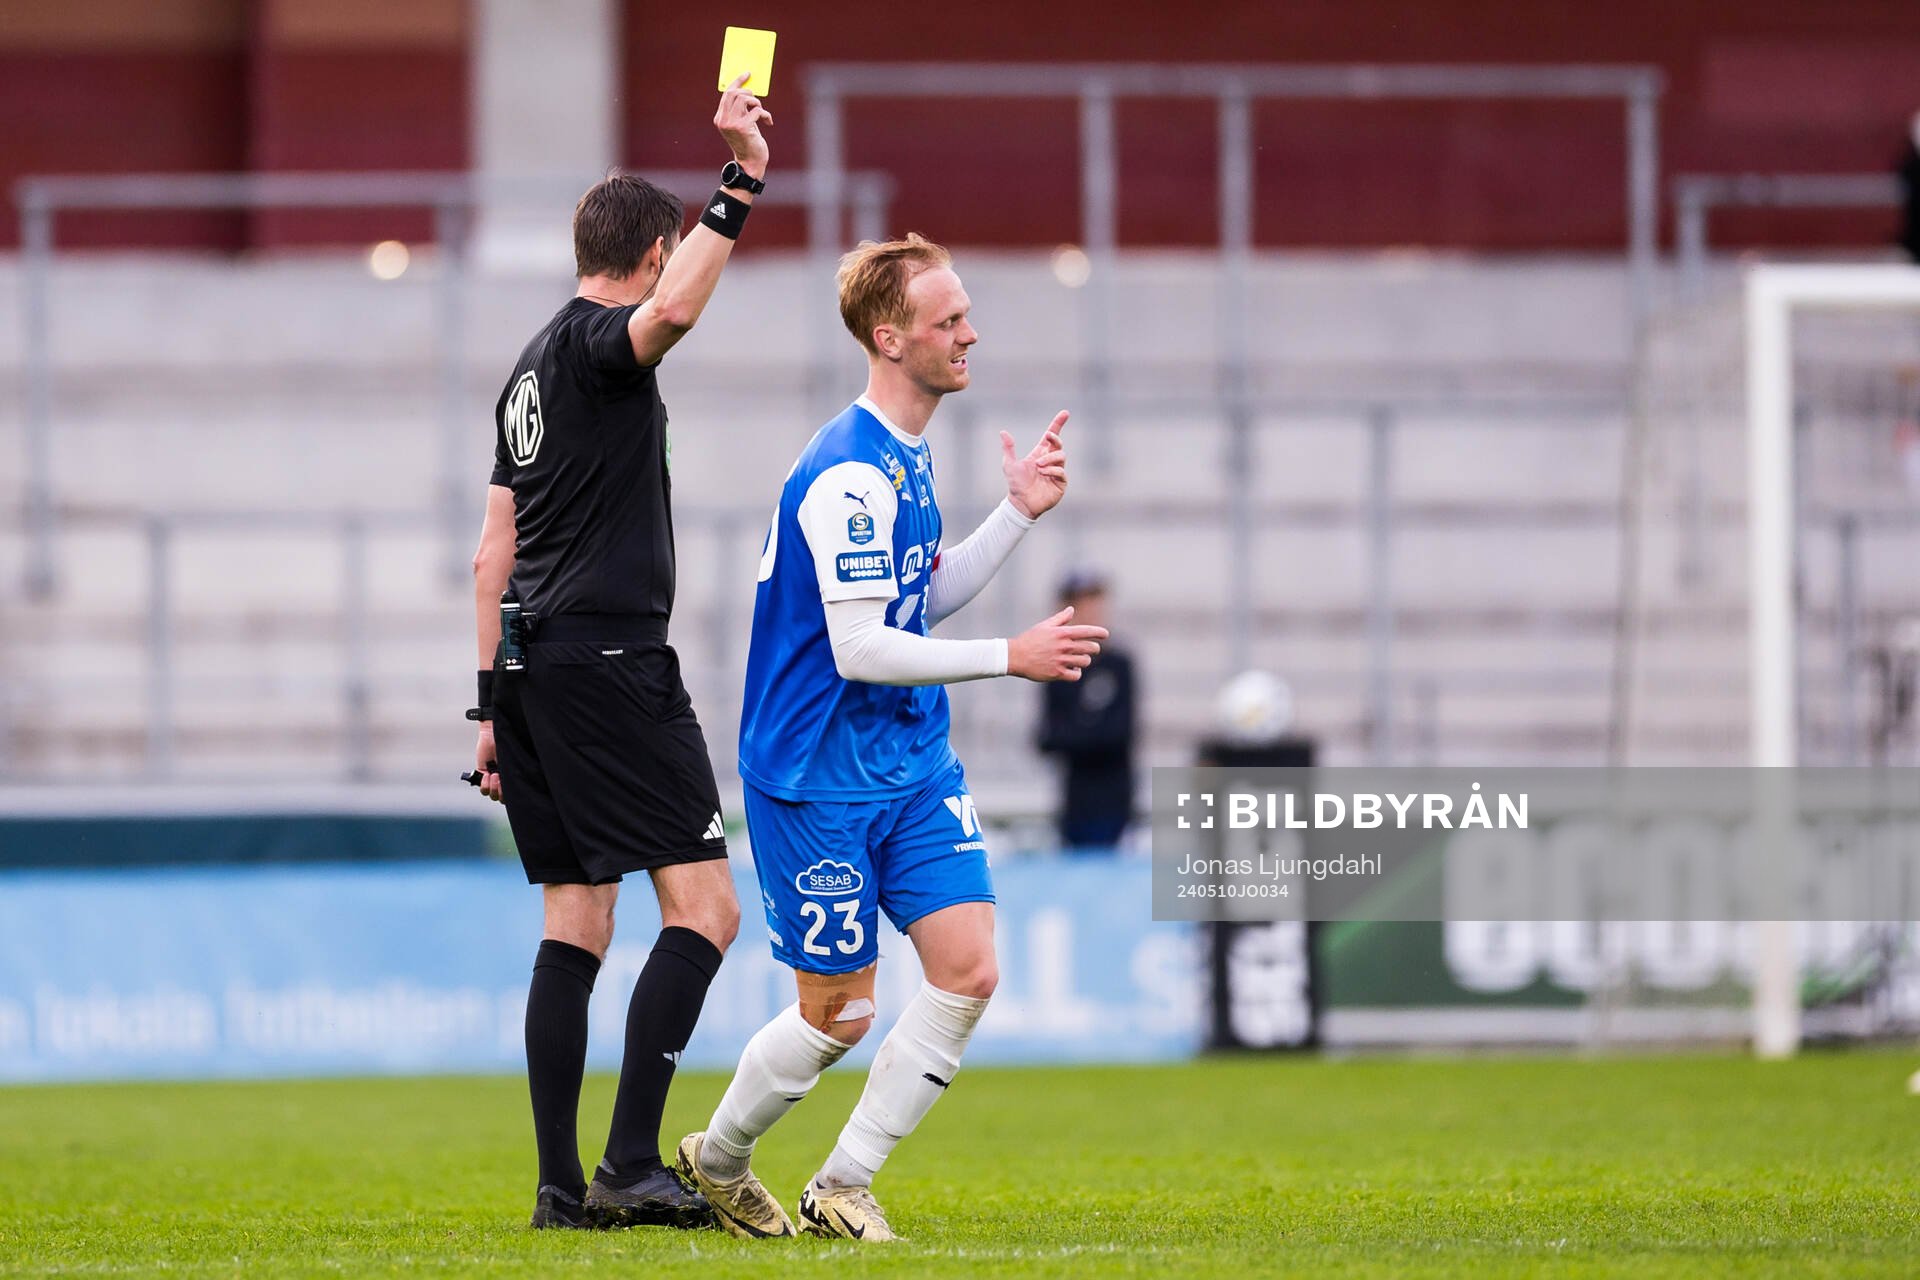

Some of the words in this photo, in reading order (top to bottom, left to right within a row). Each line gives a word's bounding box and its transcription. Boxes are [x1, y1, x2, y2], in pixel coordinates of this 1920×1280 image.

[507, 379, 539, 458] MG
[839, 555, 889, 571] UNIBET
[809, 874, 852, 887] SESAB
[800, 899, 864, 956] 23
